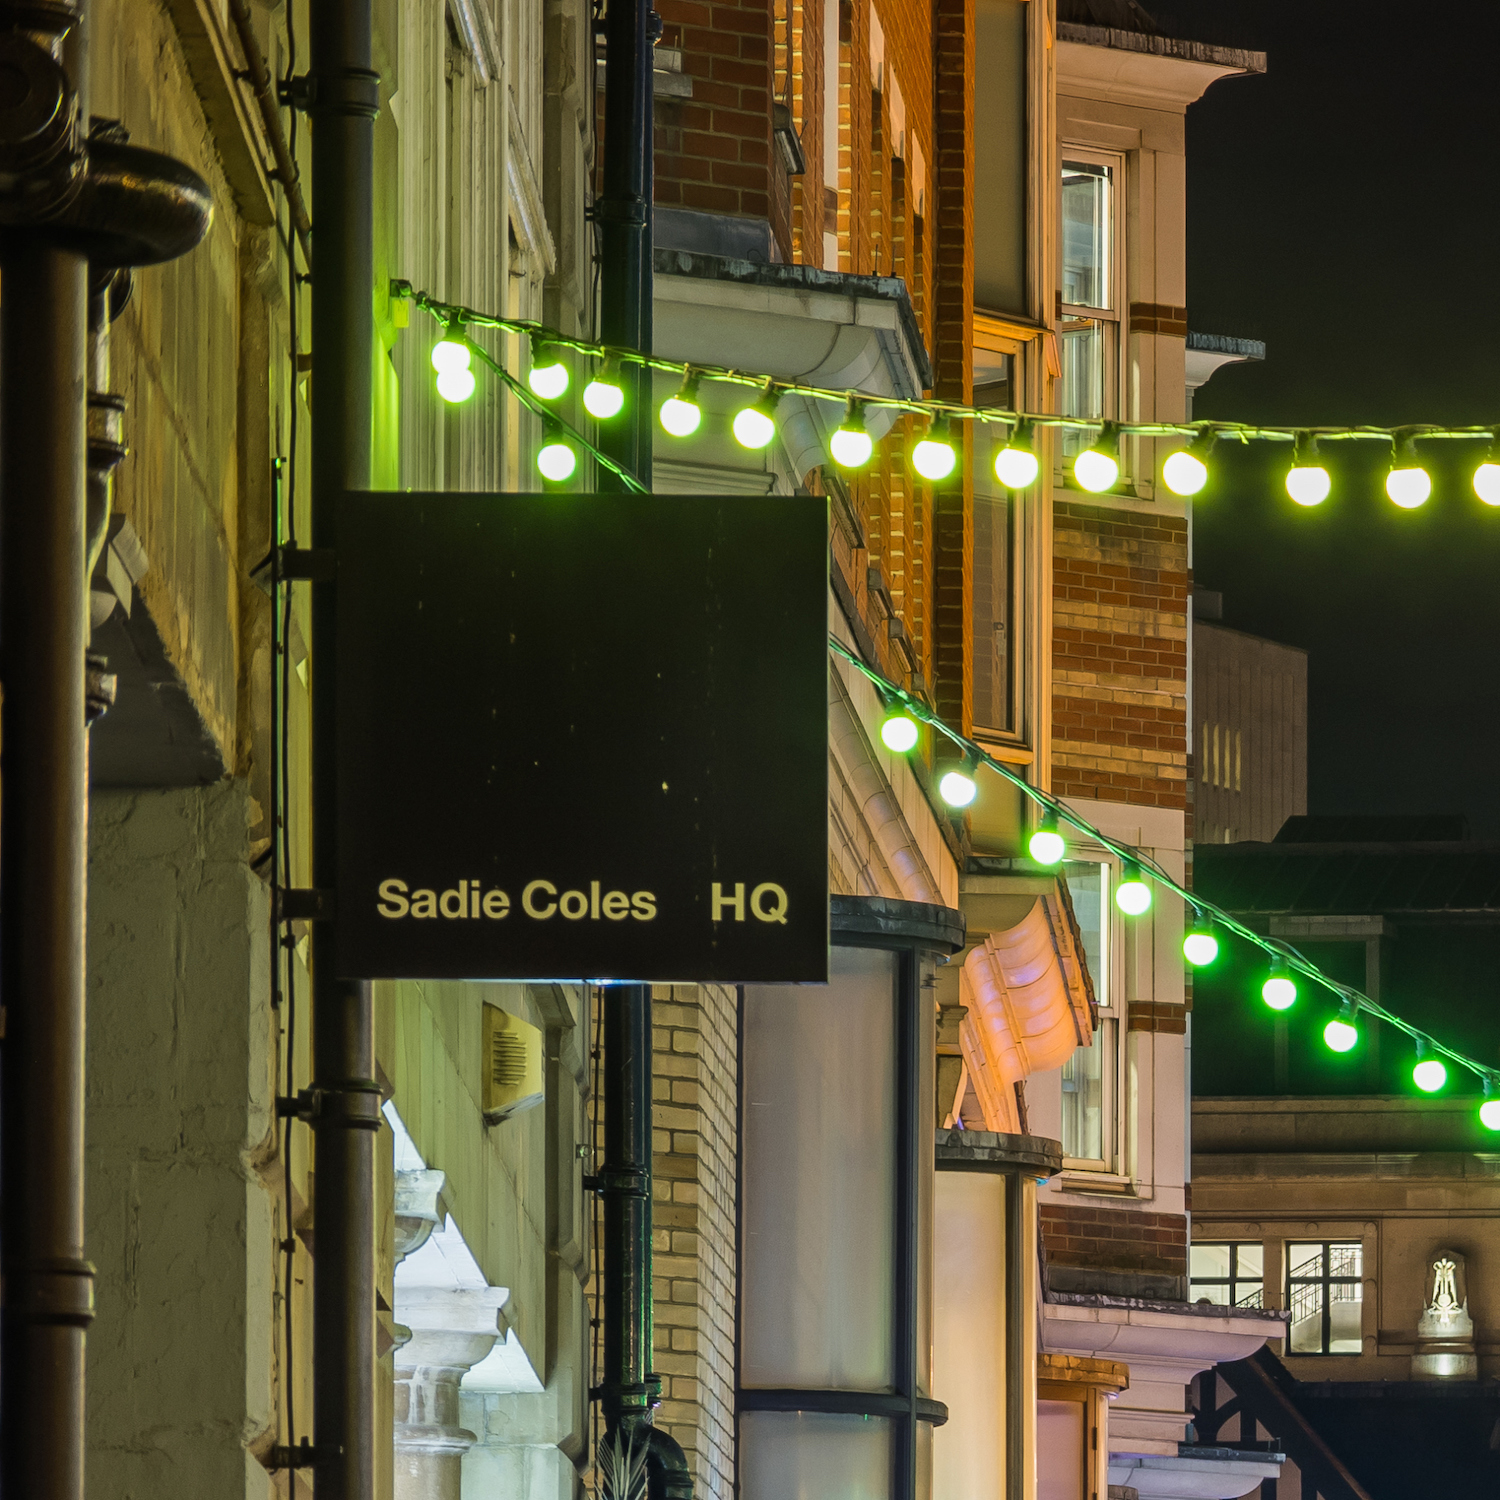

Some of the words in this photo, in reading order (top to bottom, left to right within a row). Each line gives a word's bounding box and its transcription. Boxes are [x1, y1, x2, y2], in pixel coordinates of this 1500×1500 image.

[377, 880, 511, 922] Sadie
[520, 880, 657, 922] Coles
[710, 881, 789, 925] HQ
